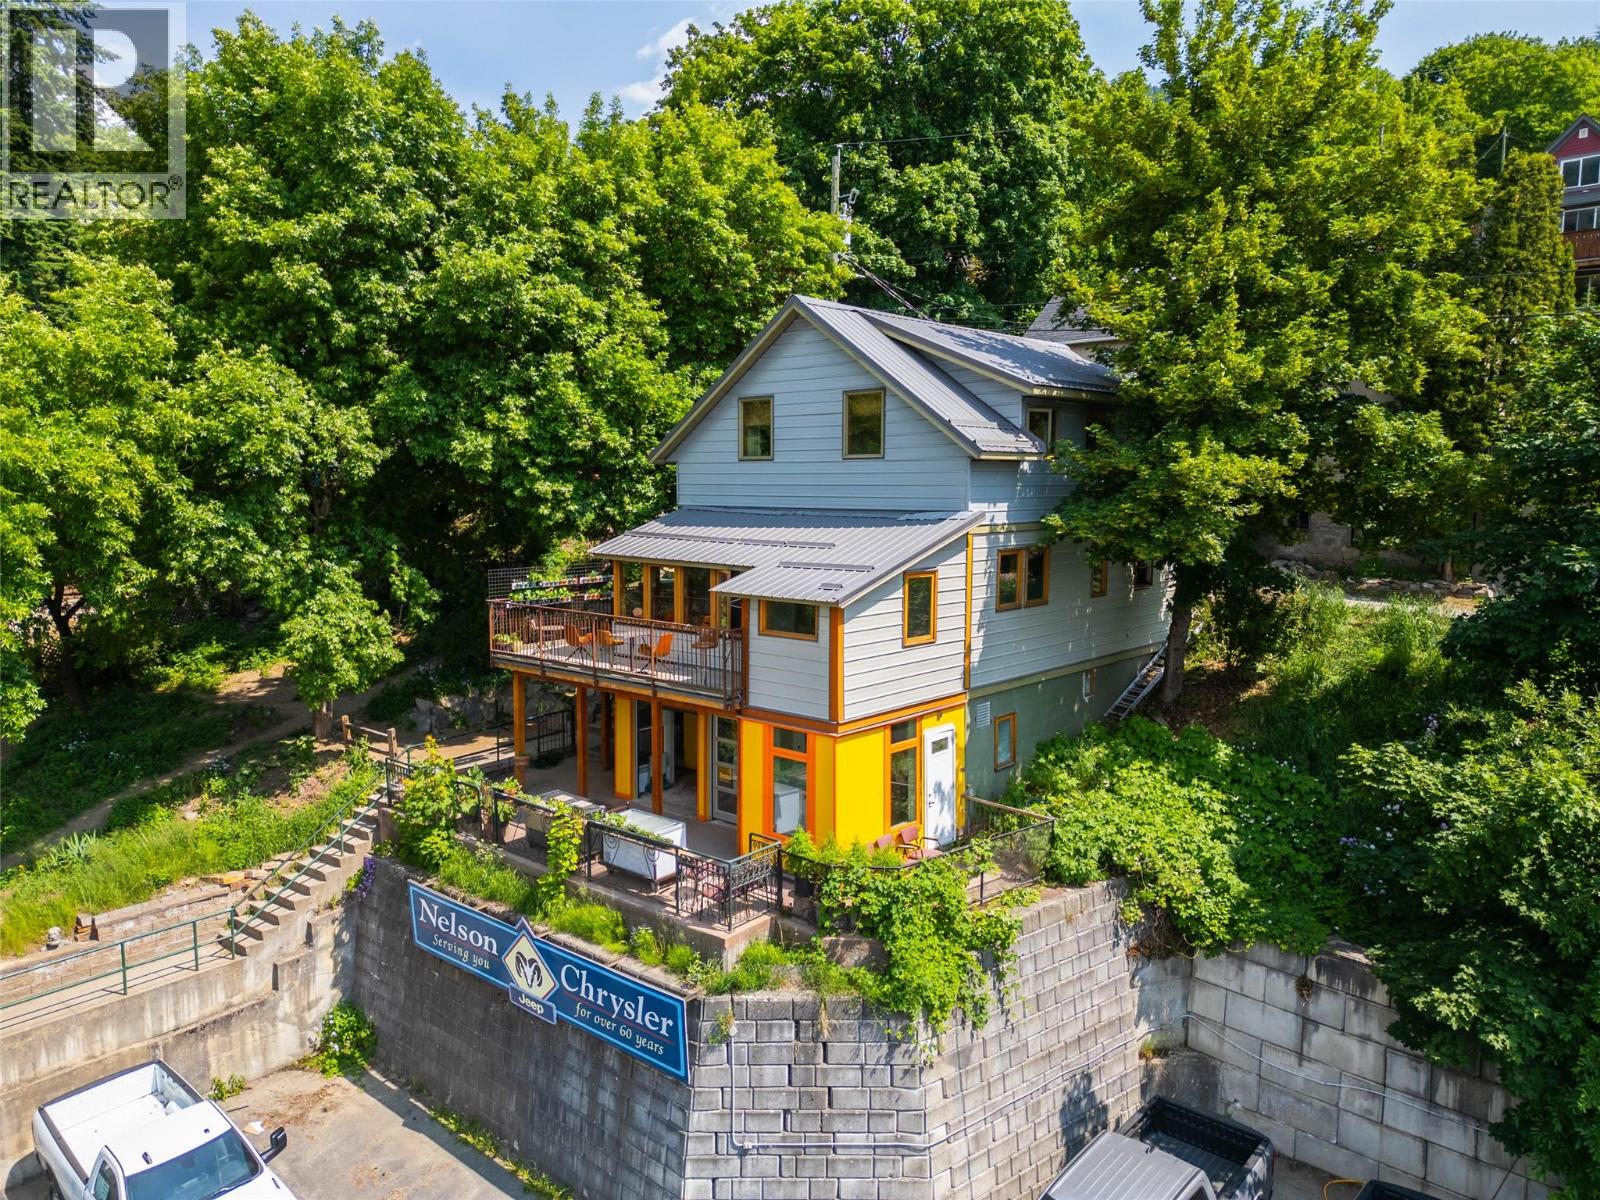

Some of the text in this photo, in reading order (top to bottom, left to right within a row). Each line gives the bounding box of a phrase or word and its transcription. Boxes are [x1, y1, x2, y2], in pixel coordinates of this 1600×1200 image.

[419, 898, 674, 1037] Nelson Chrysler
[433, 934, 664, 1055] Serving you for over 60 years
[518, 994, 544, 1014] Jeep
